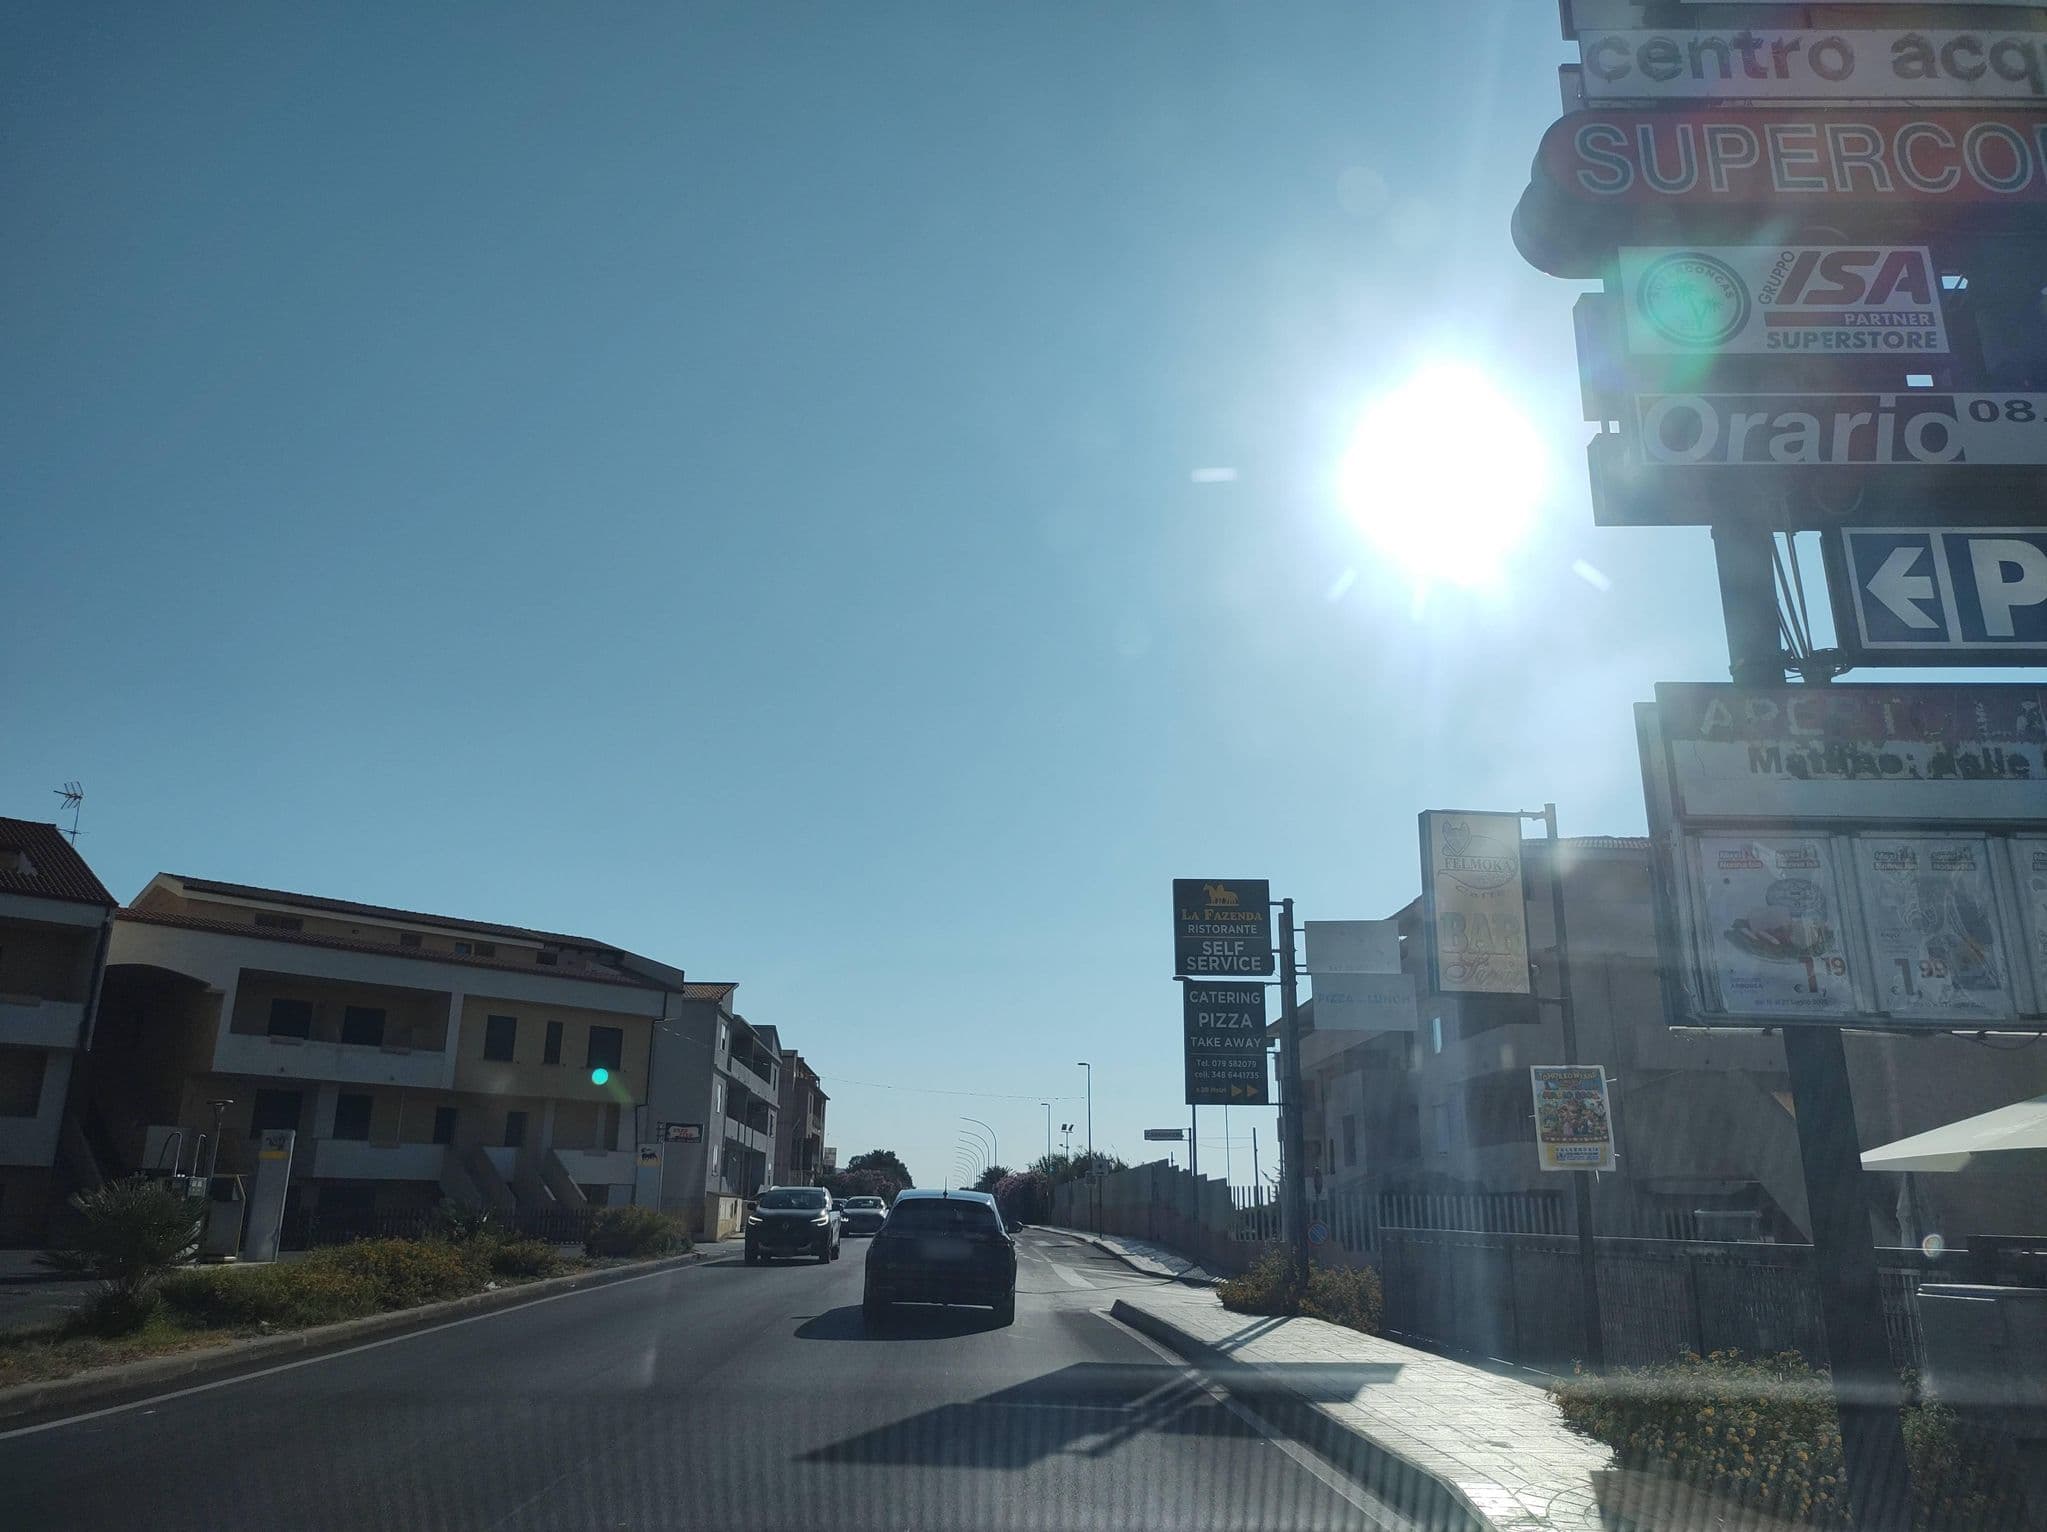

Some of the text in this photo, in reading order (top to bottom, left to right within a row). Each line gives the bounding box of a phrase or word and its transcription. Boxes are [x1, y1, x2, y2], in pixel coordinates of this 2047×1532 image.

[1584, 31, 2047, 95] centro acq
[1574, 121, 2047, 196] SUPERCO
[1757, 250, 1796, 306] GRUPPO
[1775, 250, 1933, 306] ISA
[1844, 312, 1932, 327] PARTNER
[1766, 330, 1938, 350] SUPERSTORE
[1643, 394, 1967, 464] Orario
[1967, 538, 2047, 637] P
[1181, 908, 1264, 922] LA FAZENDA
[1187, 924, 1258, 935] RISTORANTE
[1440, 911, 1522, 954] BAR
[1202, 940, 1245, 956] SELF
[1186, 956, 1262, 971] SERVICE
[1189, 990, 1261, 1005] CATERING
[1198, 1012, 1254, 1029] PIZZA
[1190, 1036, 1262, 1049] TAKE AWAY
